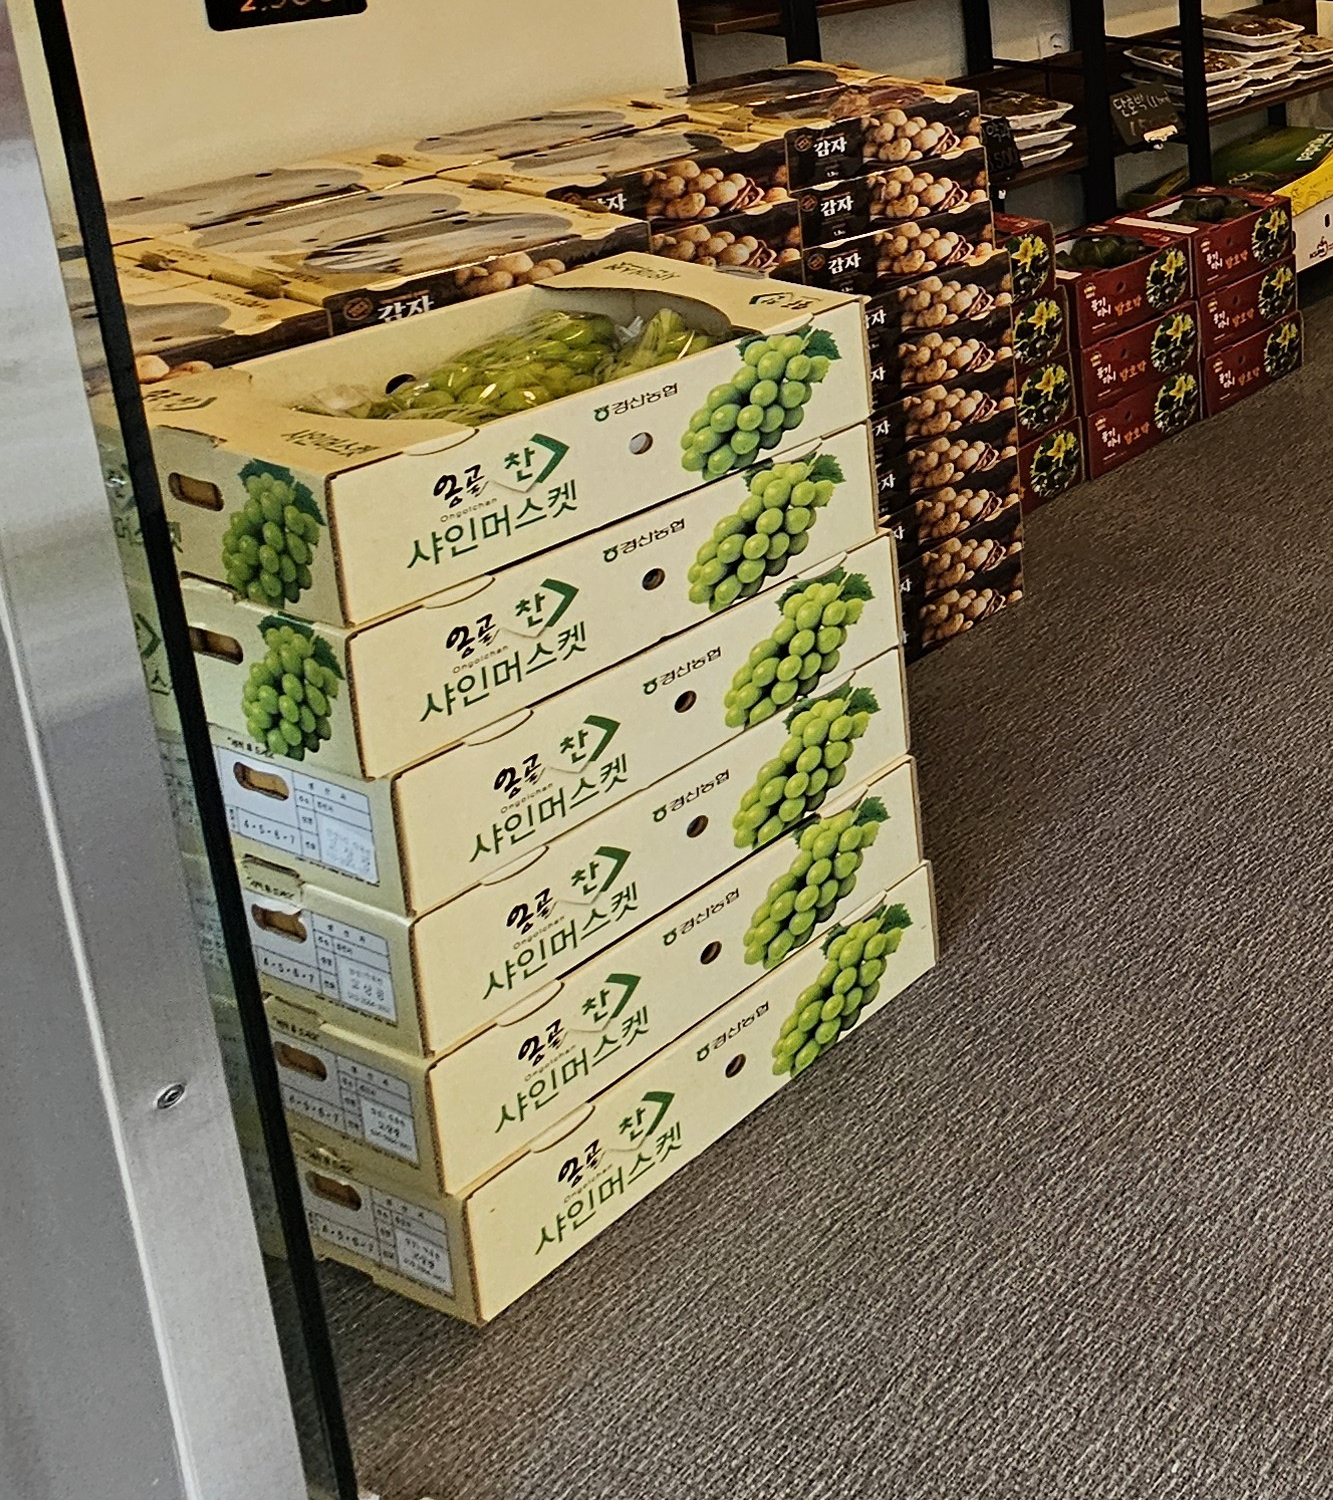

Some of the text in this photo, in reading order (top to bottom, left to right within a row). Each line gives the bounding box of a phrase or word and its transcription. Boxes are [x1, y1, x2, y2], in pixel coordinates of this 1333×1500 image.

[814, 136, 847, 158] 감자
[820, 195, 854, 217] 감자
[827, 253, 862, 276] 감자
[612, 383, 679, 415] 경산농협
[407, 479, 578, 569] 샤인머스켓
[440, 498, 497, 523] Ongolchan
[620, 518, 686, 554] 경산농협
[419, 621, 587, 722] 샤인머스켓
[661, 647, 722, 685] 경산농협
[469, 753, 628, 862] 샤인머스켓
[669, 769, 730, 811] 경산농협
[482, 882, 638, 1000] 샤인머스켓
[712, 1001, 770, 1051] 경산농협
[494, 1006, 649, 1133] 샤인머스켓
[535, 1122, 682, 1255] 샤인머스켓
